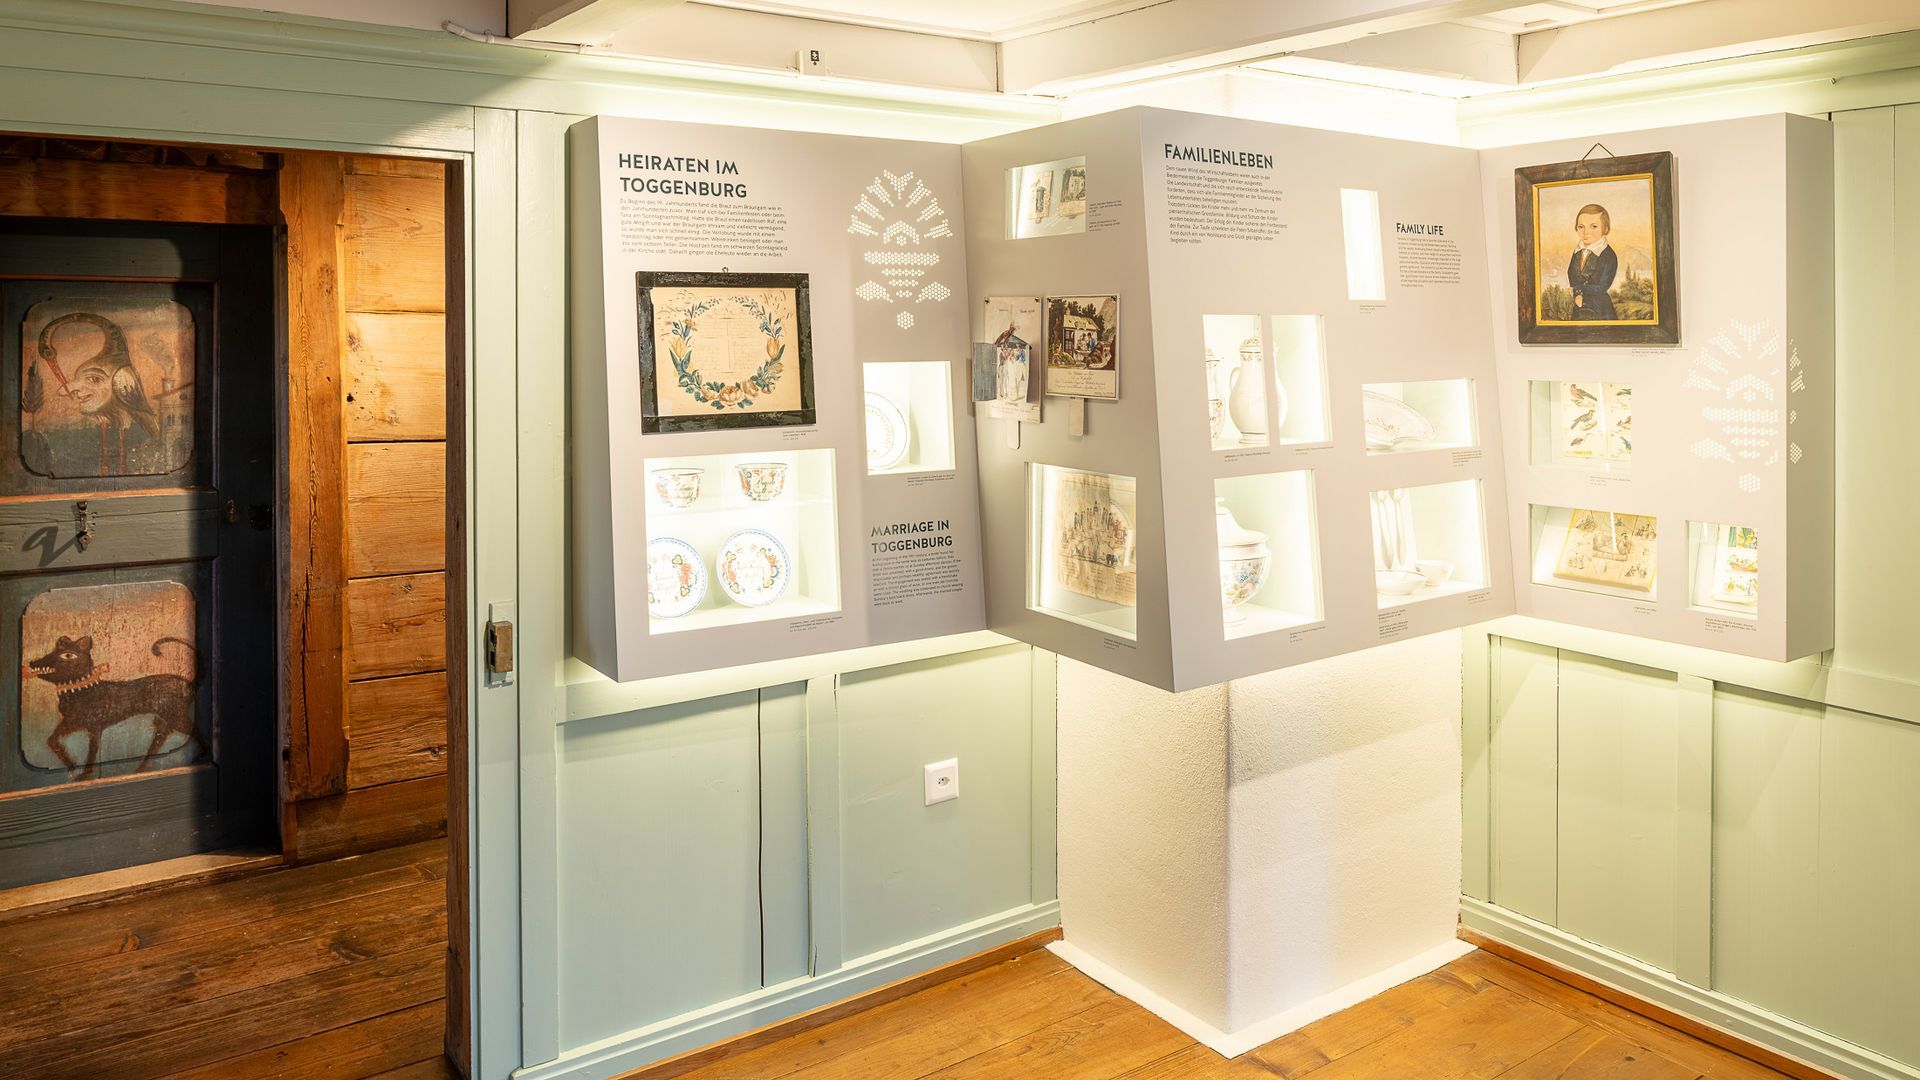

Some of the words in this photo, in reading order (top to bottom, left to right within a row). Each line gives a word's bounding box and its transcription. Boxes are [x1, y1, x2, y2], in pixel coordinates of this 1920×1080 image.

[619, 153, 709, 173] HEIRATEN
[716, 160, 739, 175] IM
[1165, 144, 1273, 169] FAMILIENLEBEN
[620, 177, 747, 198] TOGGENBURG
[1396, 222, 1425, 235] FAMILY
[1427, 225, 1444, 236] LIFE
[871, 521, 934, 537] MARRIAGE
[937, 519, 950, 530] IN
[871, 536, 953, 553] TOGGENBURG
